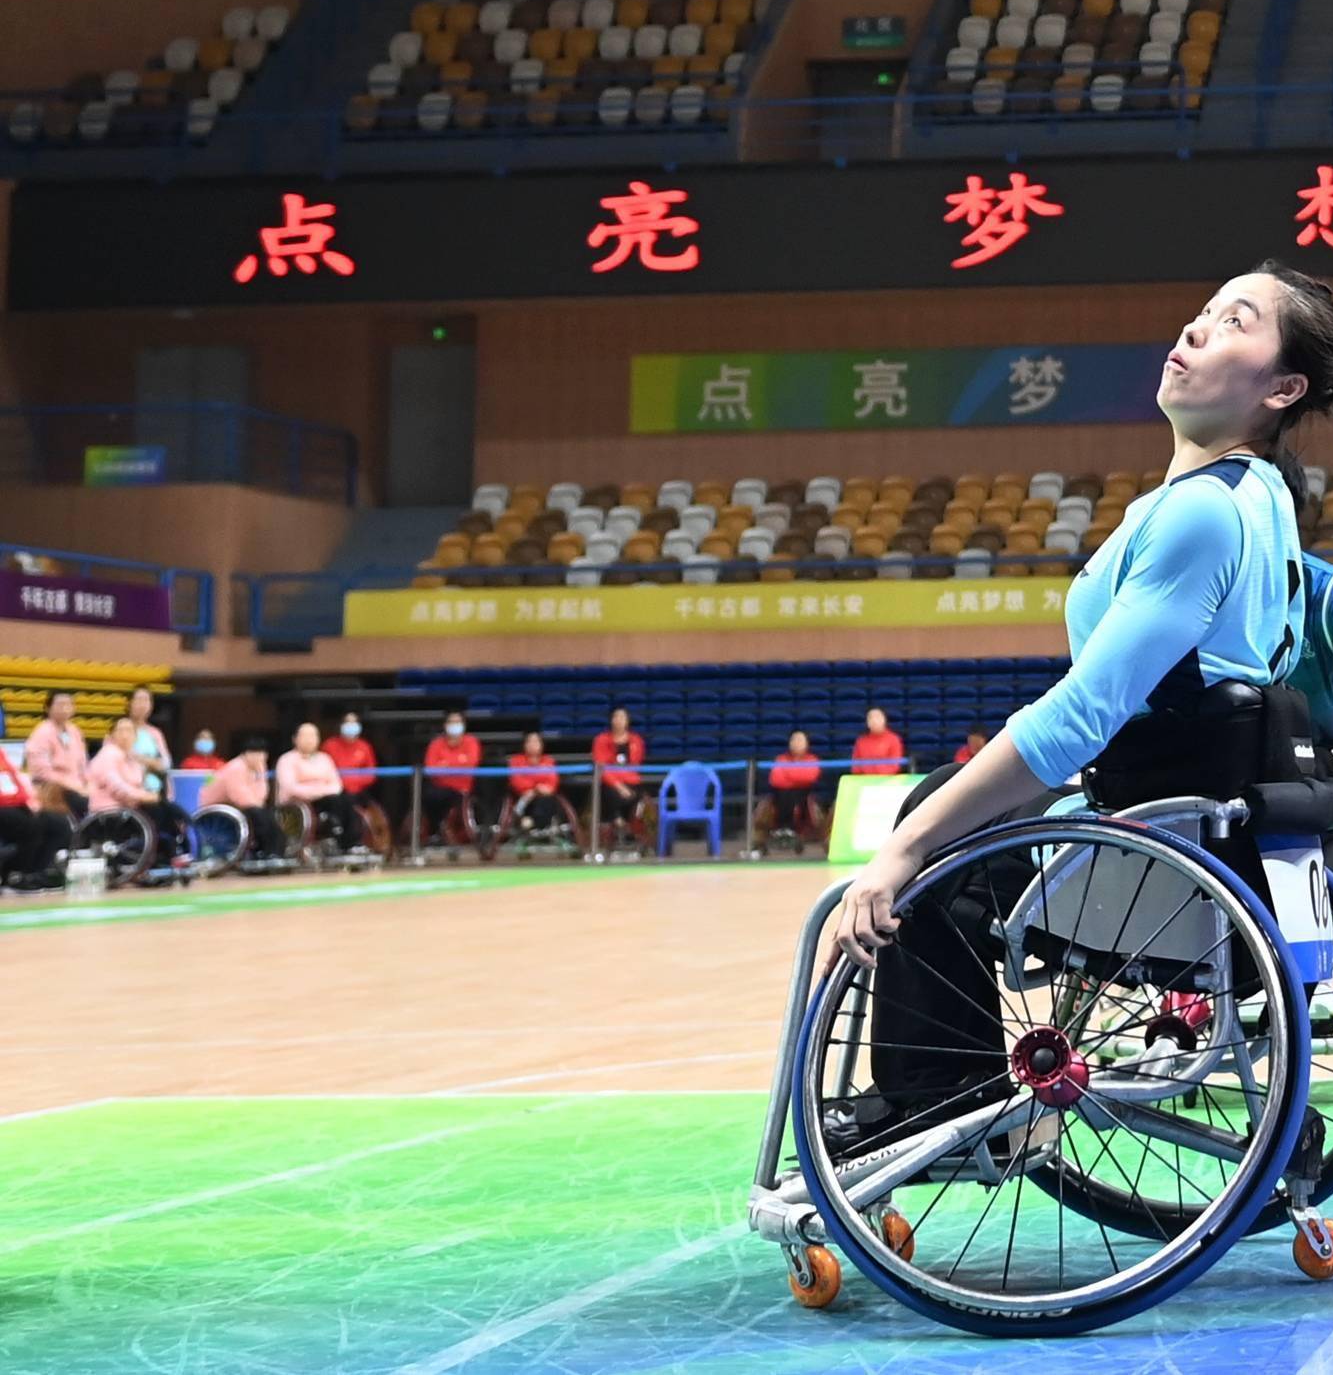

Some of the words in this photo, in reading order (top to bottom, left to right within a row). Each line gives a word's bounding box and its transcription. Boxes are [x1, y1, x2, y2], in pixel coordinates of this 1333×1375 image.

[234, 193, 355, 283] 点
[587, 181, 699, 273] 亮
[943, 172, 1064, 269] 梦
[698, 363, 753, 422] 点
[853, 359, 908, 418] 亮
[1008, 355, 1065, 415] 梦
